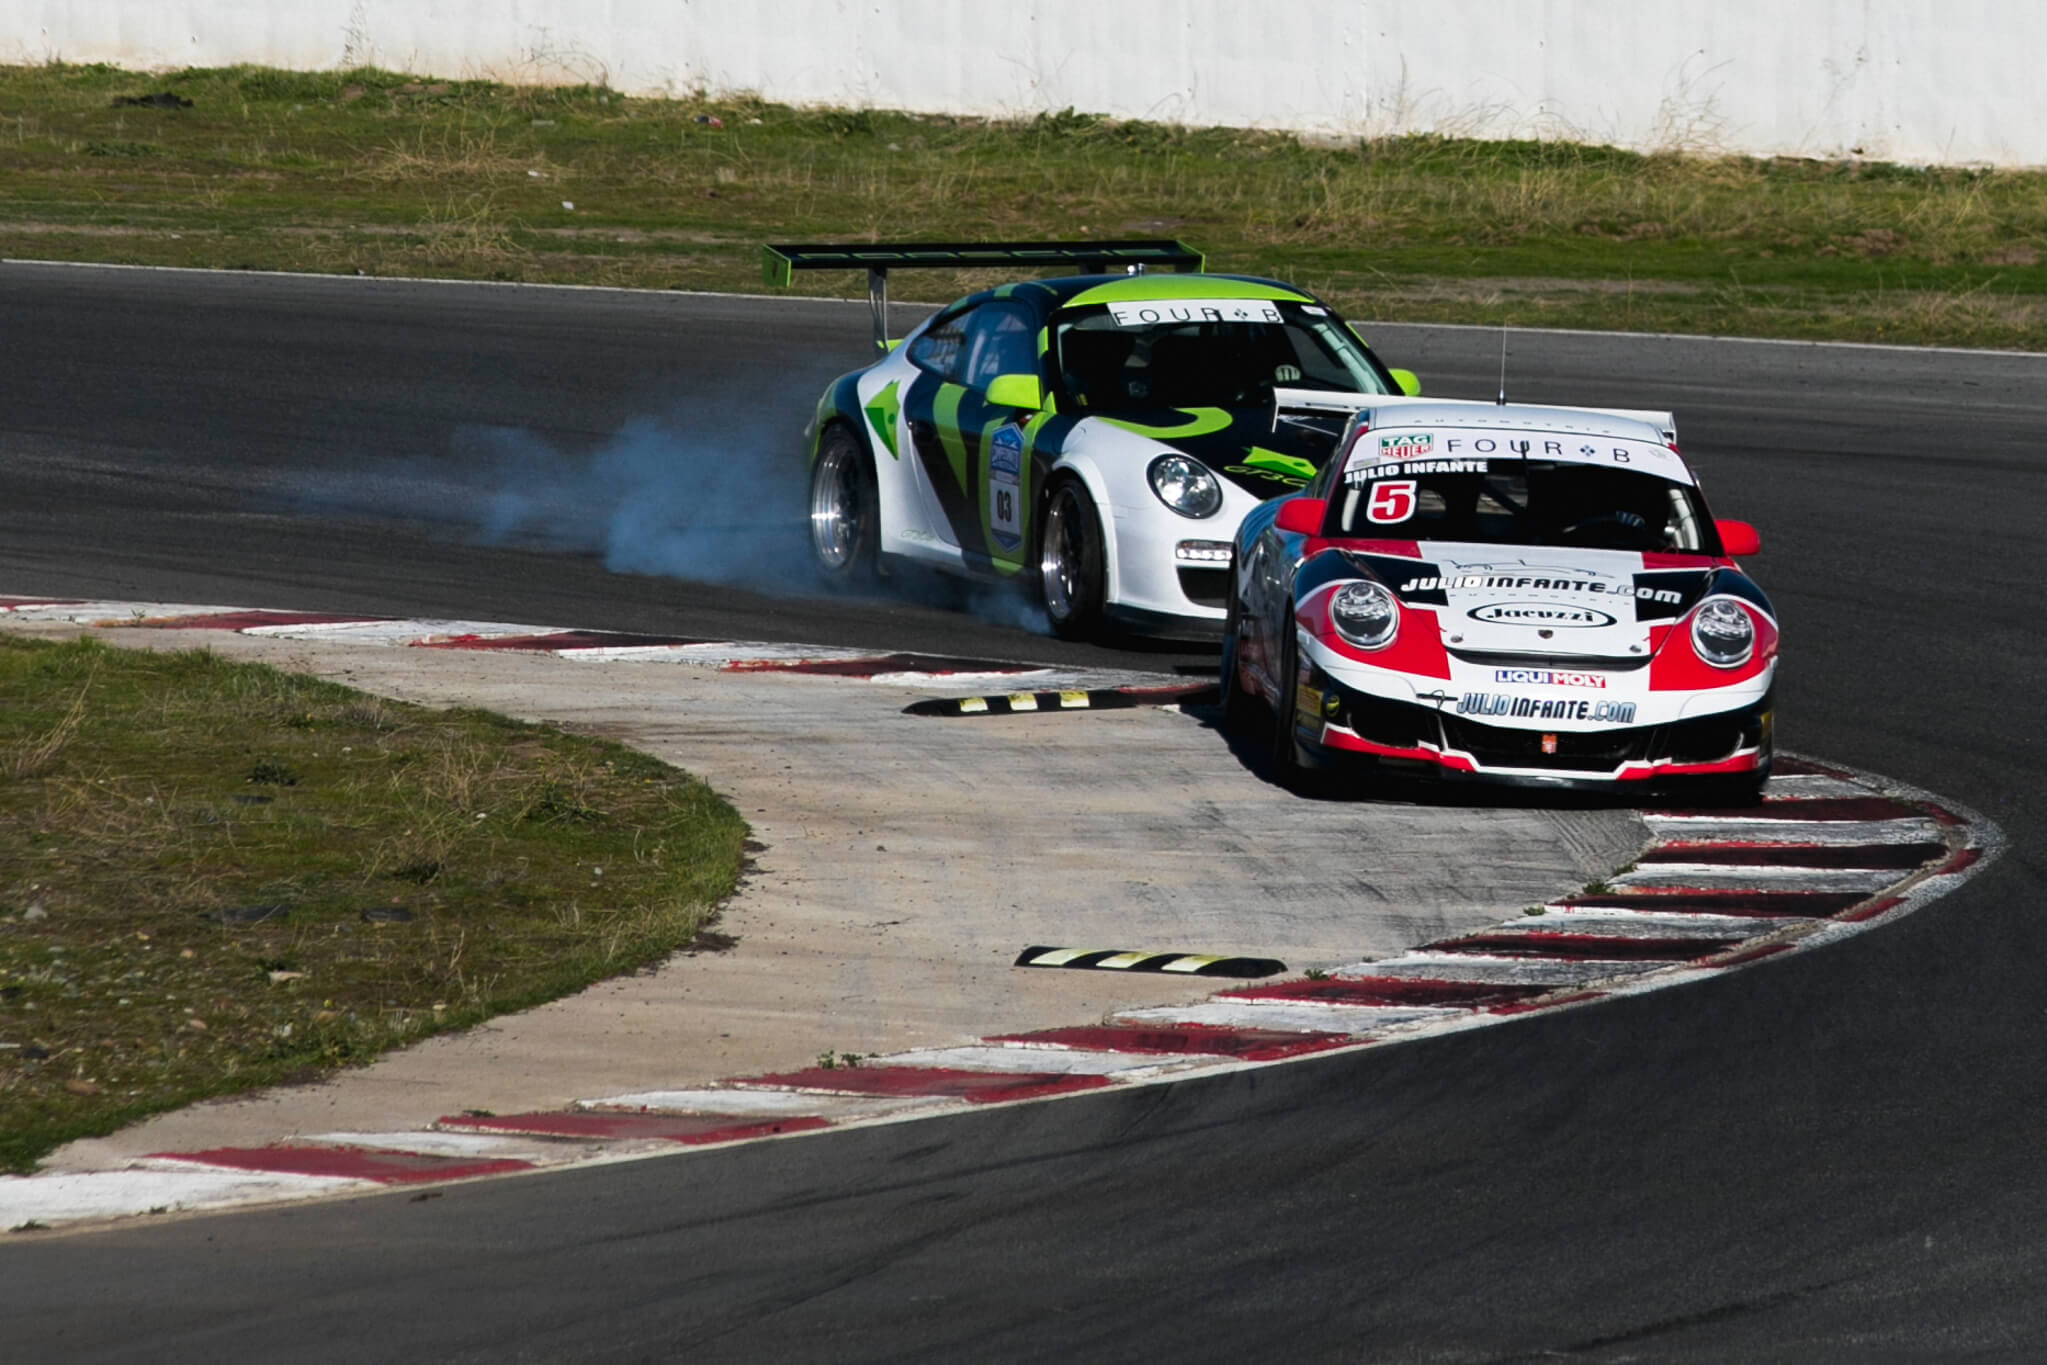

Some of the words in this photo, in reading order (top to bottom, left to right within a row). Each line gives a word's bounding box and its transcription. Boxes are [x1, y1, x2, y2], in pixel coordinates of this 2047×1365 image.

[1114, 307, 1218, 325] FOUR
[1262, 308, 1281, 323] B
[1382, 435, 1430, 447] TAG
[1447, 438, 1562, 455] FOUR
[1613, 448, 1630, 462] B
[1382, 445, 1431, 458] HEUER
[1344, 465, 1399, 484] JULIO
[1404, 461, 1488, 474] INFANTE
[996, 490, 1012, 522] 03
[1368, 482, 1414, 522] 5
[1486, 608, 1596, 623] Jacuzzi
[1499, 671, 1550, 685] LIQUI
[1552, 673, 1606, 688] MOLY
